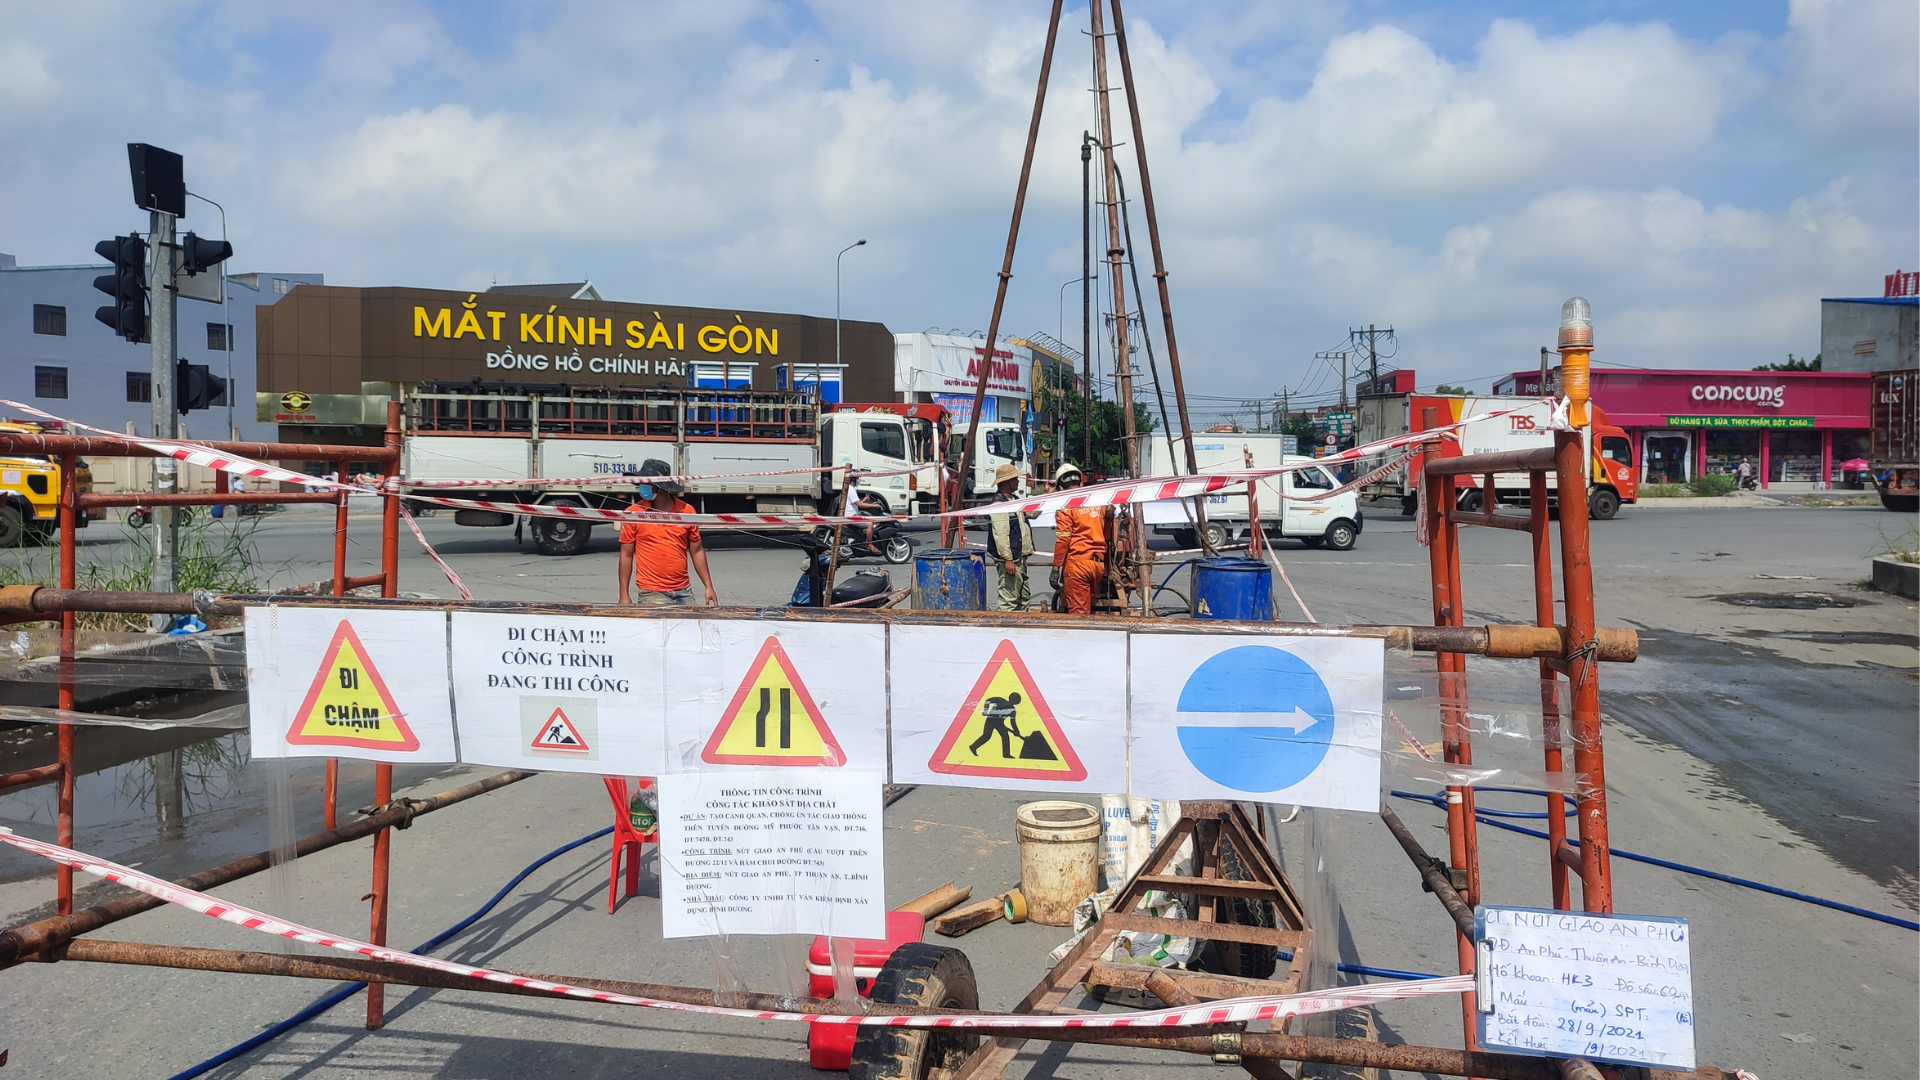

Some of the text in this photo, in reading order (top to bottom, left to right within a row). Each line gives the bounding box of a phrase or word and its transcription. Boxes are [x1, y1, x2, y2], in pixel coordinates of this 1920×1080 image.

[414, 294, 778, 355] MẮT KÍNH SÀI GÒN
[486, 345, 686, 376] ĐỒNG HỒ CHÍNH HÃ
[988, 359, 1019, 381] THÀNH
[1691, 385, 1785, 408] concung
[1509, 415, 1536, 430] TBS
[507, 627, 526, 641] ĐI
[531, 626, 584, 646] CHẬM
[502, 647, 613, 668] CÔNG TRÌNH
[339, 667, 359, 690] ĐI
[487, 674, 629, 693] ĐANG THI CÔNG
[324, 701, 380, 733] CHẬM
[720, 787, 751, 797] THÔNG
[770, 786, 794, 796] CÔNG
[796, 787, 822, 797] TRÌNH
[706, 799, 731, 809] CÔNG
[732, 799, 750, 809] TÁC
[780, 798, 796, 809] SÁT
[813, 799, 838, 809] CHẤT
[746, 813, 769, 822] QUAN,
[822, 813, 840, 821] GIAO
[842, 812, 867, 821] THÔNG
[685, 847, 705, 855] CÔNG
[790, 846, 804, 854] PHÚ
[849, 847, 868, 856] TRÊN
[725, 870, 739, 878] NÚT
[729, 893, 749, 901] CÔNG
[763, 894, 784, 902] TNHH
[1558, 915, 1605, 933] GIAO
[1609, 925, 1638, 938] AN
[1647, 924, 1686, 943] PHÚ
[1517, 943, 1536, 956] An
[1539, 944, 1562, 960] Phú
[1610, 953, 1626, 966] An
[1561, 972, 1594, 987] HK3
